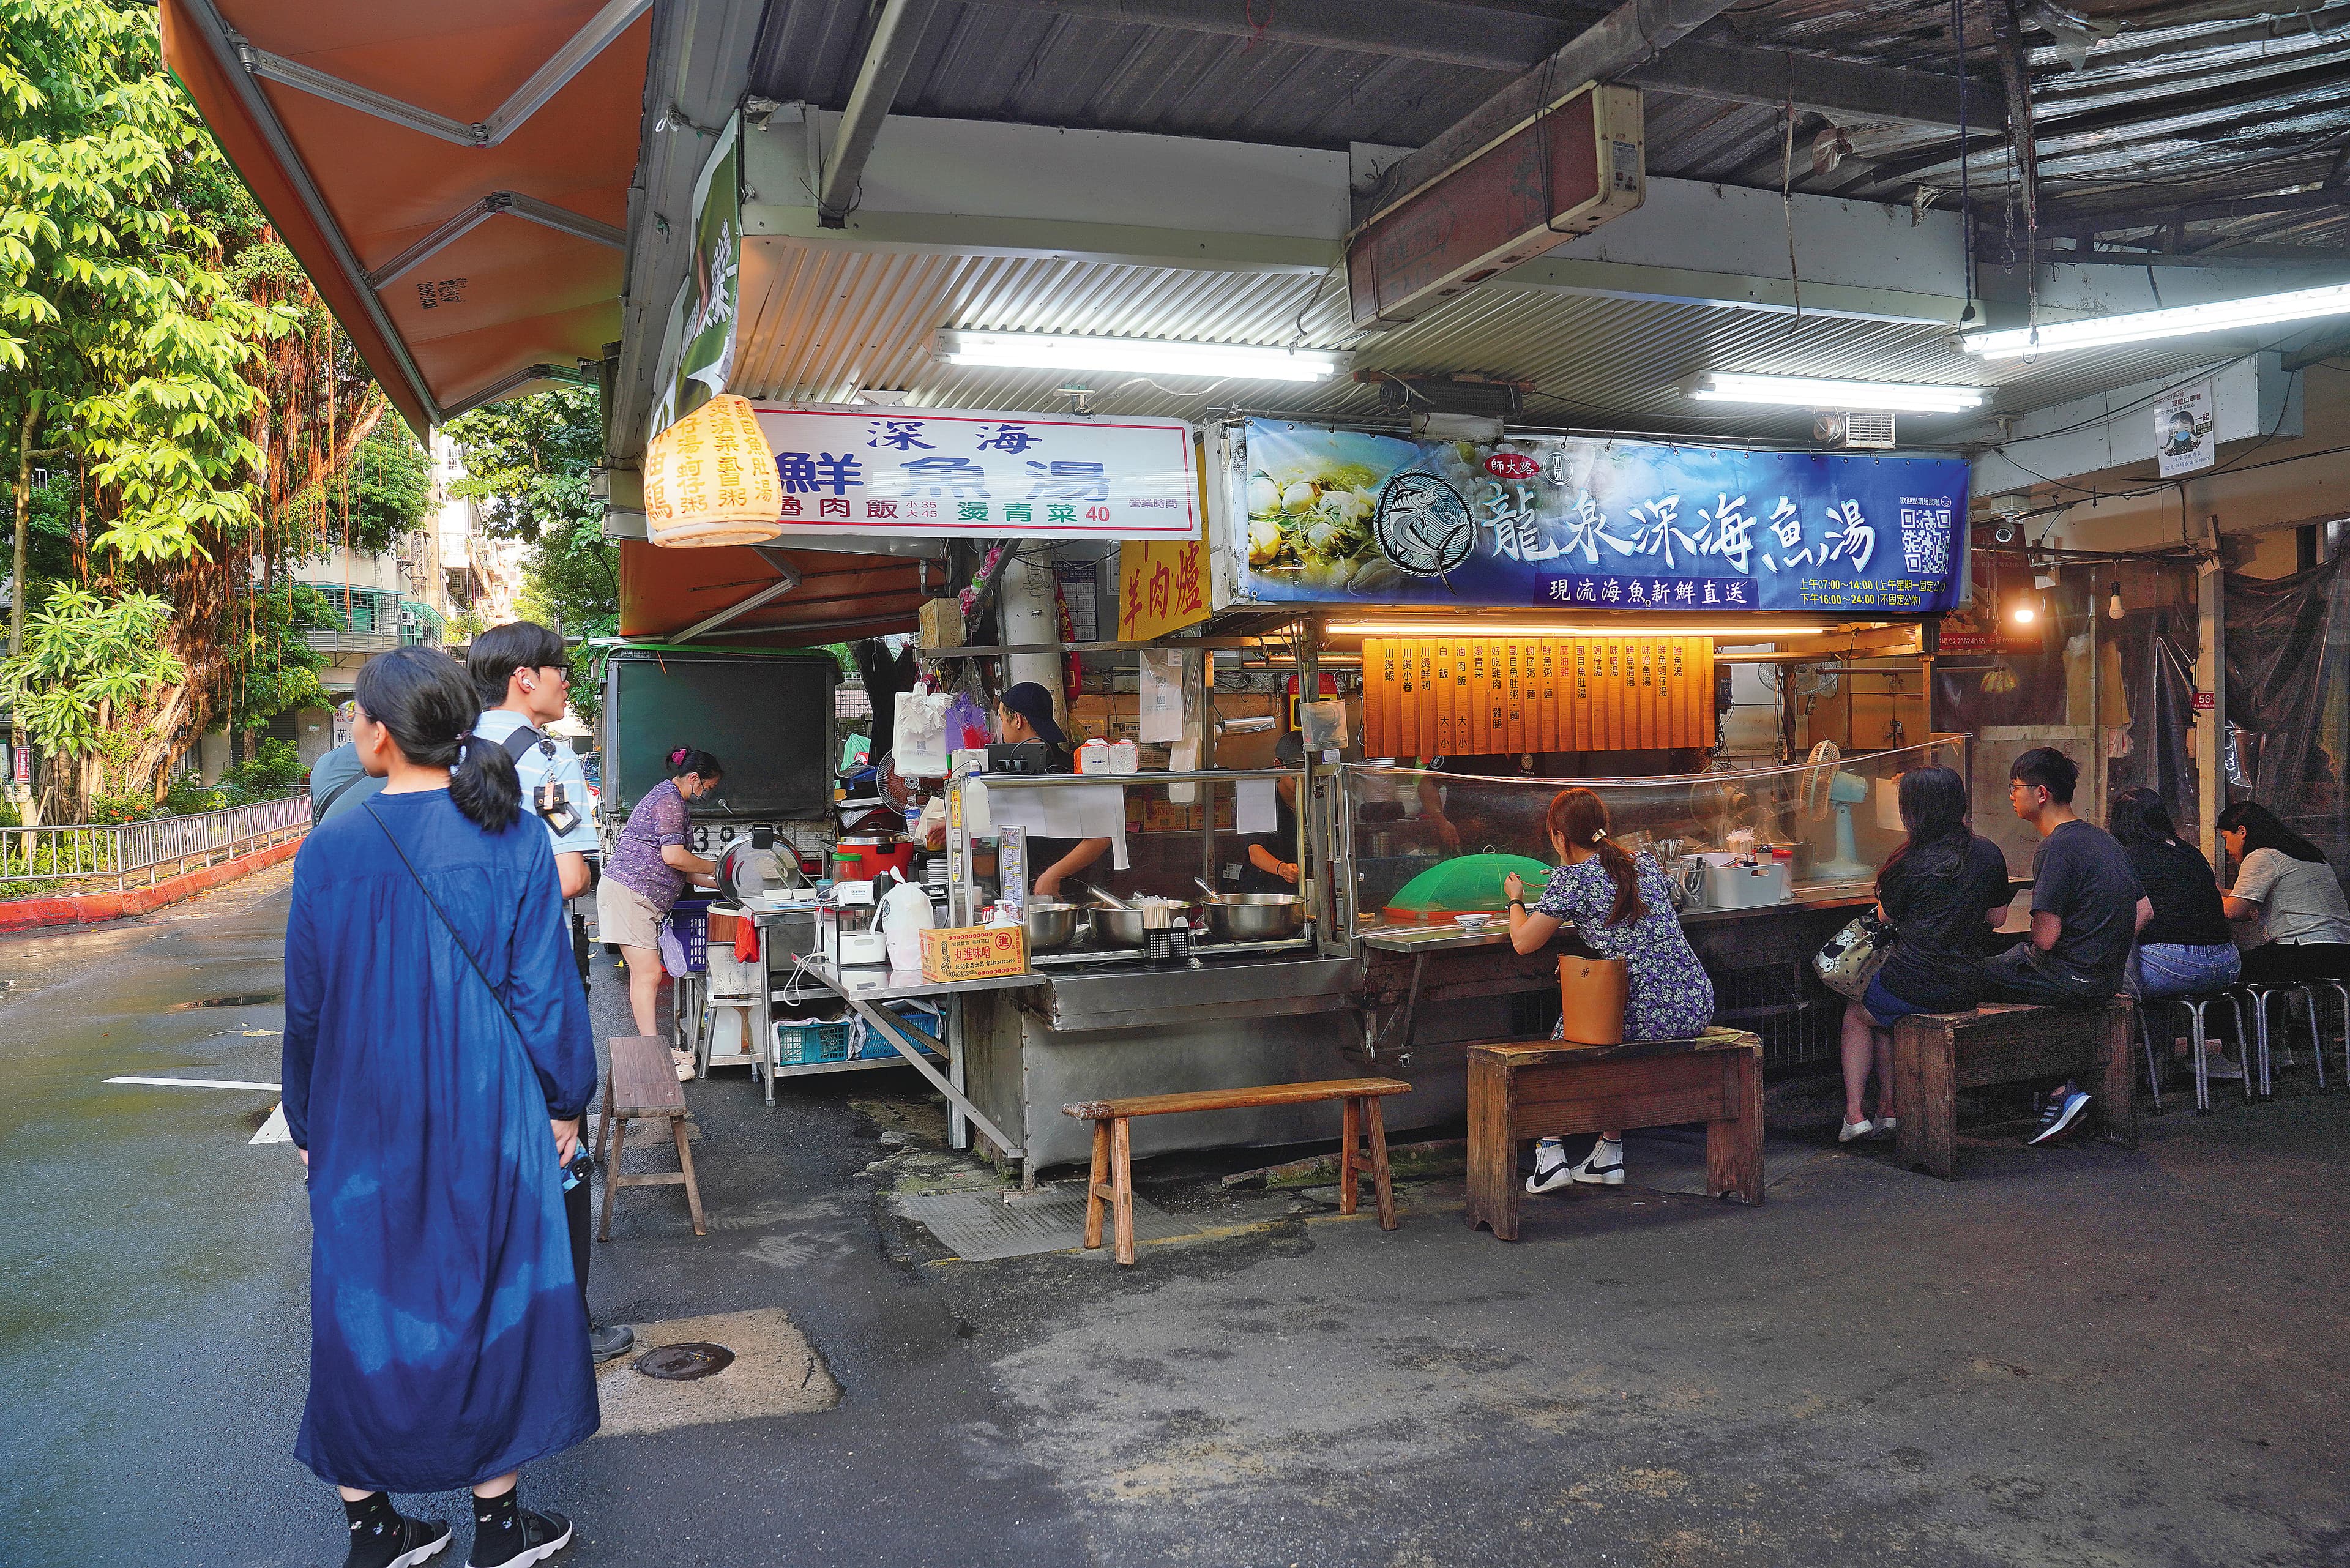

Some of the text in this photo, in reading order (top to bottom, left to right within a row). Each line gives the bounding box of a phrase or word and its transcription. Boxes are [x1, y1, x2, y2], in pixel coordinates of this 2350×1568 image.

[2195, 412, 2210, 422] 一起
[867, 420, 1043, 455] 深海
[774, 452, 1111, 501] 鮮魚湯
[1491, 458, 1535, 475] 師大路
[957, 502, 1110, 523] 燙青菜 40
[1481, 482, 1876, 574] 龍泉深海魚湯
[1124, 540, 1203, 640] 羊肉爐
[1548, 577, 1748, 605] 現流海魚新鮮直送
[1874, 579, 1946, 593] (上午星期一固定公)
[1384, 648, 1395, 681] 川燙蝦
[1402, 648, 1413, 692] 川燙小卷
[1420, 647, 1431, 690] 川燙鮮蚵
[1457, 646, 1466, 686] 滷肉飯
[1474, 646, 1484, 679] 燙青菜
[1559, 646, 1570, 677] 麻油雞
[1576, 646, 1587, 698] 虱目魚肚湯
[1593, 645, 1602, 677] 蚵仔湯
[1609, 645, 1619, 676] 味噌湯
[1625, 645, 1635, 687] 鮮魚清湯
[1641, 645, 1651, 687] 味噌魚湯
[1657, 645, 1668, 696] 鮮魚蚵仔湯
[2198, 695, 2210, 703] 56
[954, 946, 991, 962] 丸進味噌
